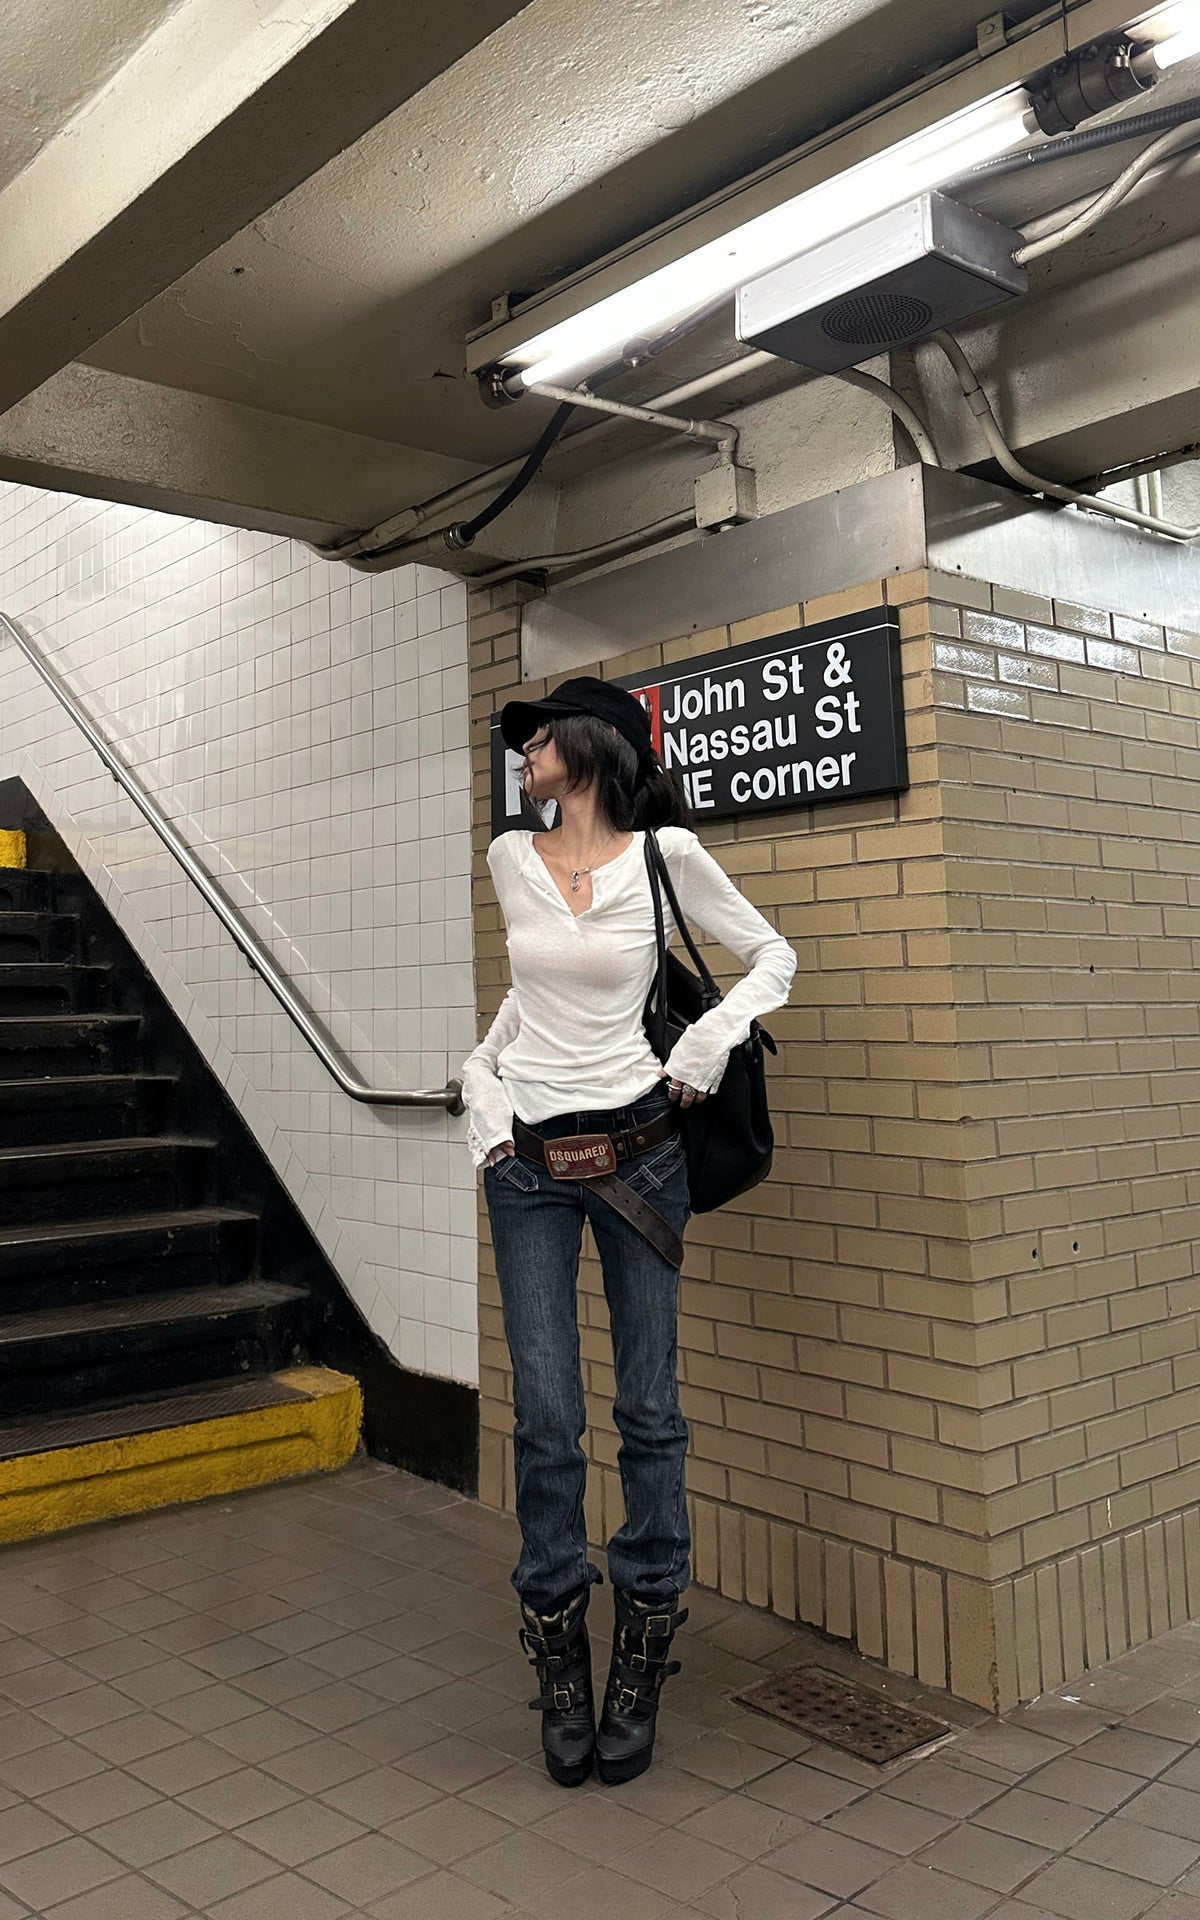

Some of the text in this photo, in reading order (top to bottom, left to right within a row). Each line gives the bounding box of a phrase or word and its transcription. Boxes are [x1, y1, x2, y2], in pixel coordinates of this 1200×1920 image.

[662, 676, 745, 724] John
[762, 654, 805, 701] St
[823, 641, 853, 688] &
[663, 713, 797, 770] Nassau
[814, 690, 862, 739] St
[730, 752, 856, 803] corner
